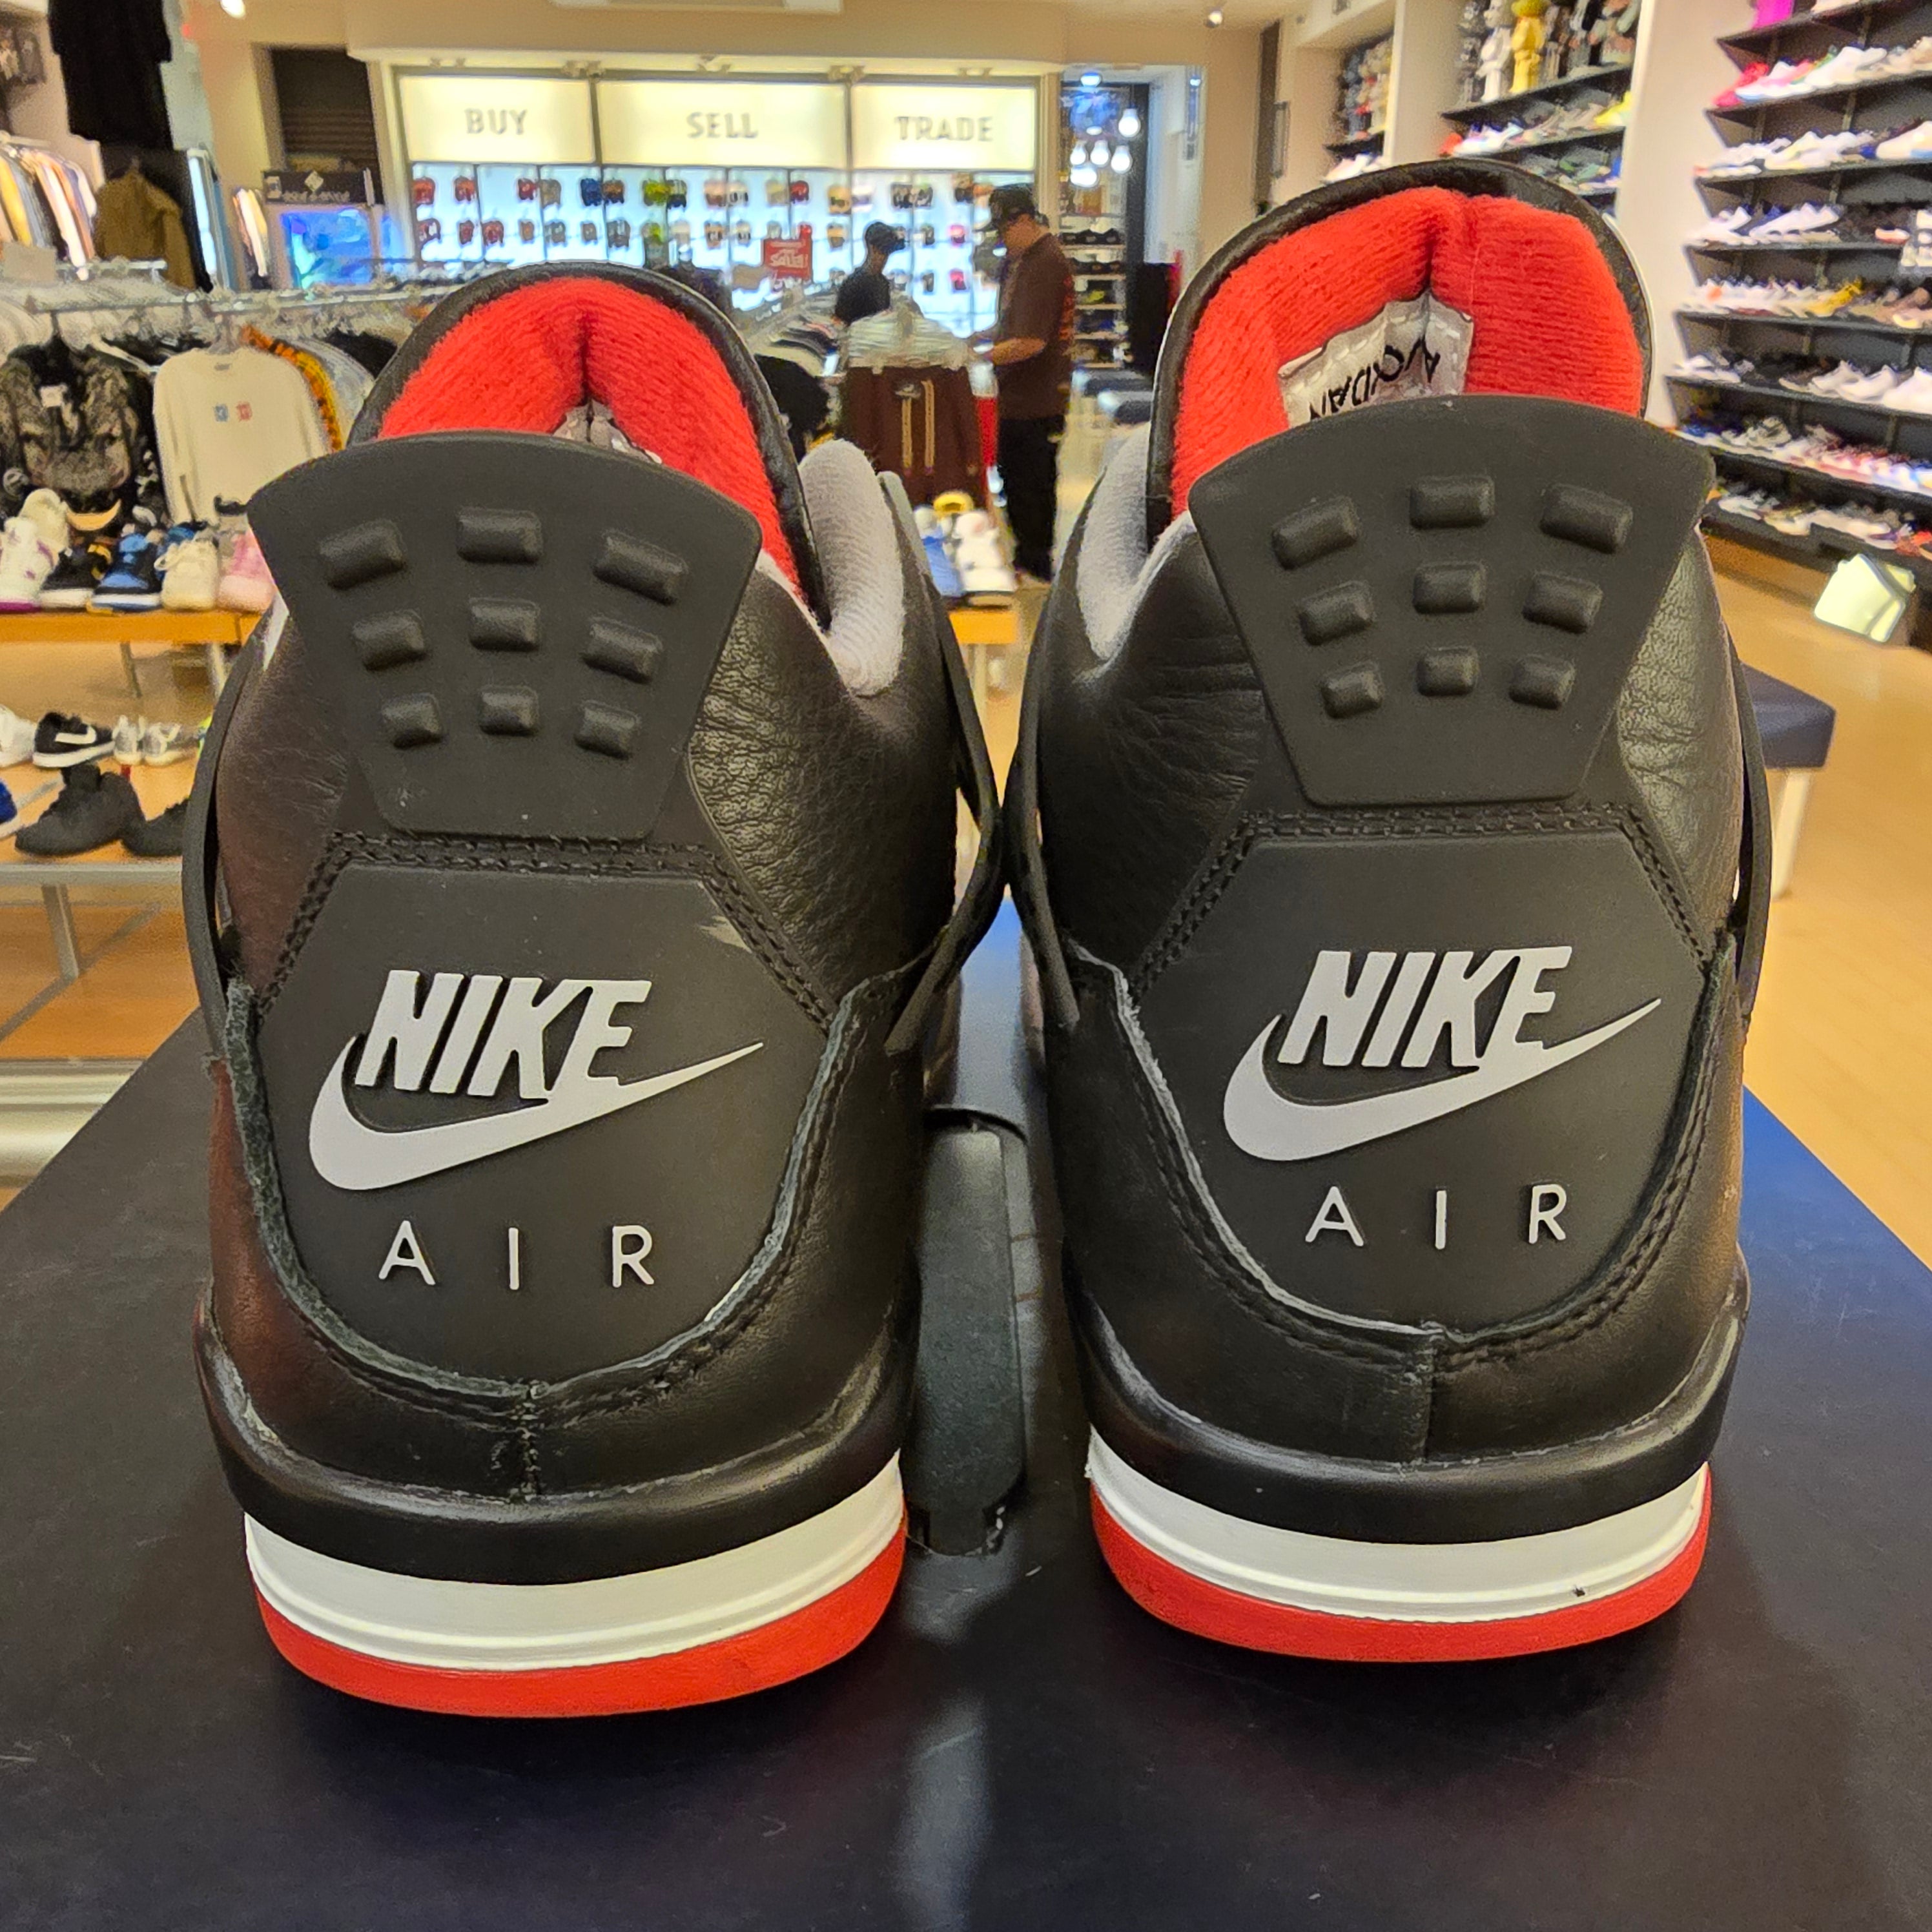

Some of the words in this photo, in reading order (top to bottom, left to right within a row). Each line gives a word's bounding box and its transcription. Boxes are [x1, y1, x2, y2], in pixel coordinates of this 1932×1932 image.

[465, 108, 528, 135] BUY
[686, 112, 759, 138] SELL
[894, 116, 994, 141] TRADE
[355, 970, 652, 1100] NIKE
[1277, 946, 1572, 1069] NIKE
[1305, 1184, 1567, 1250] AIR
[378, 1220, 654, 1290] AIR
